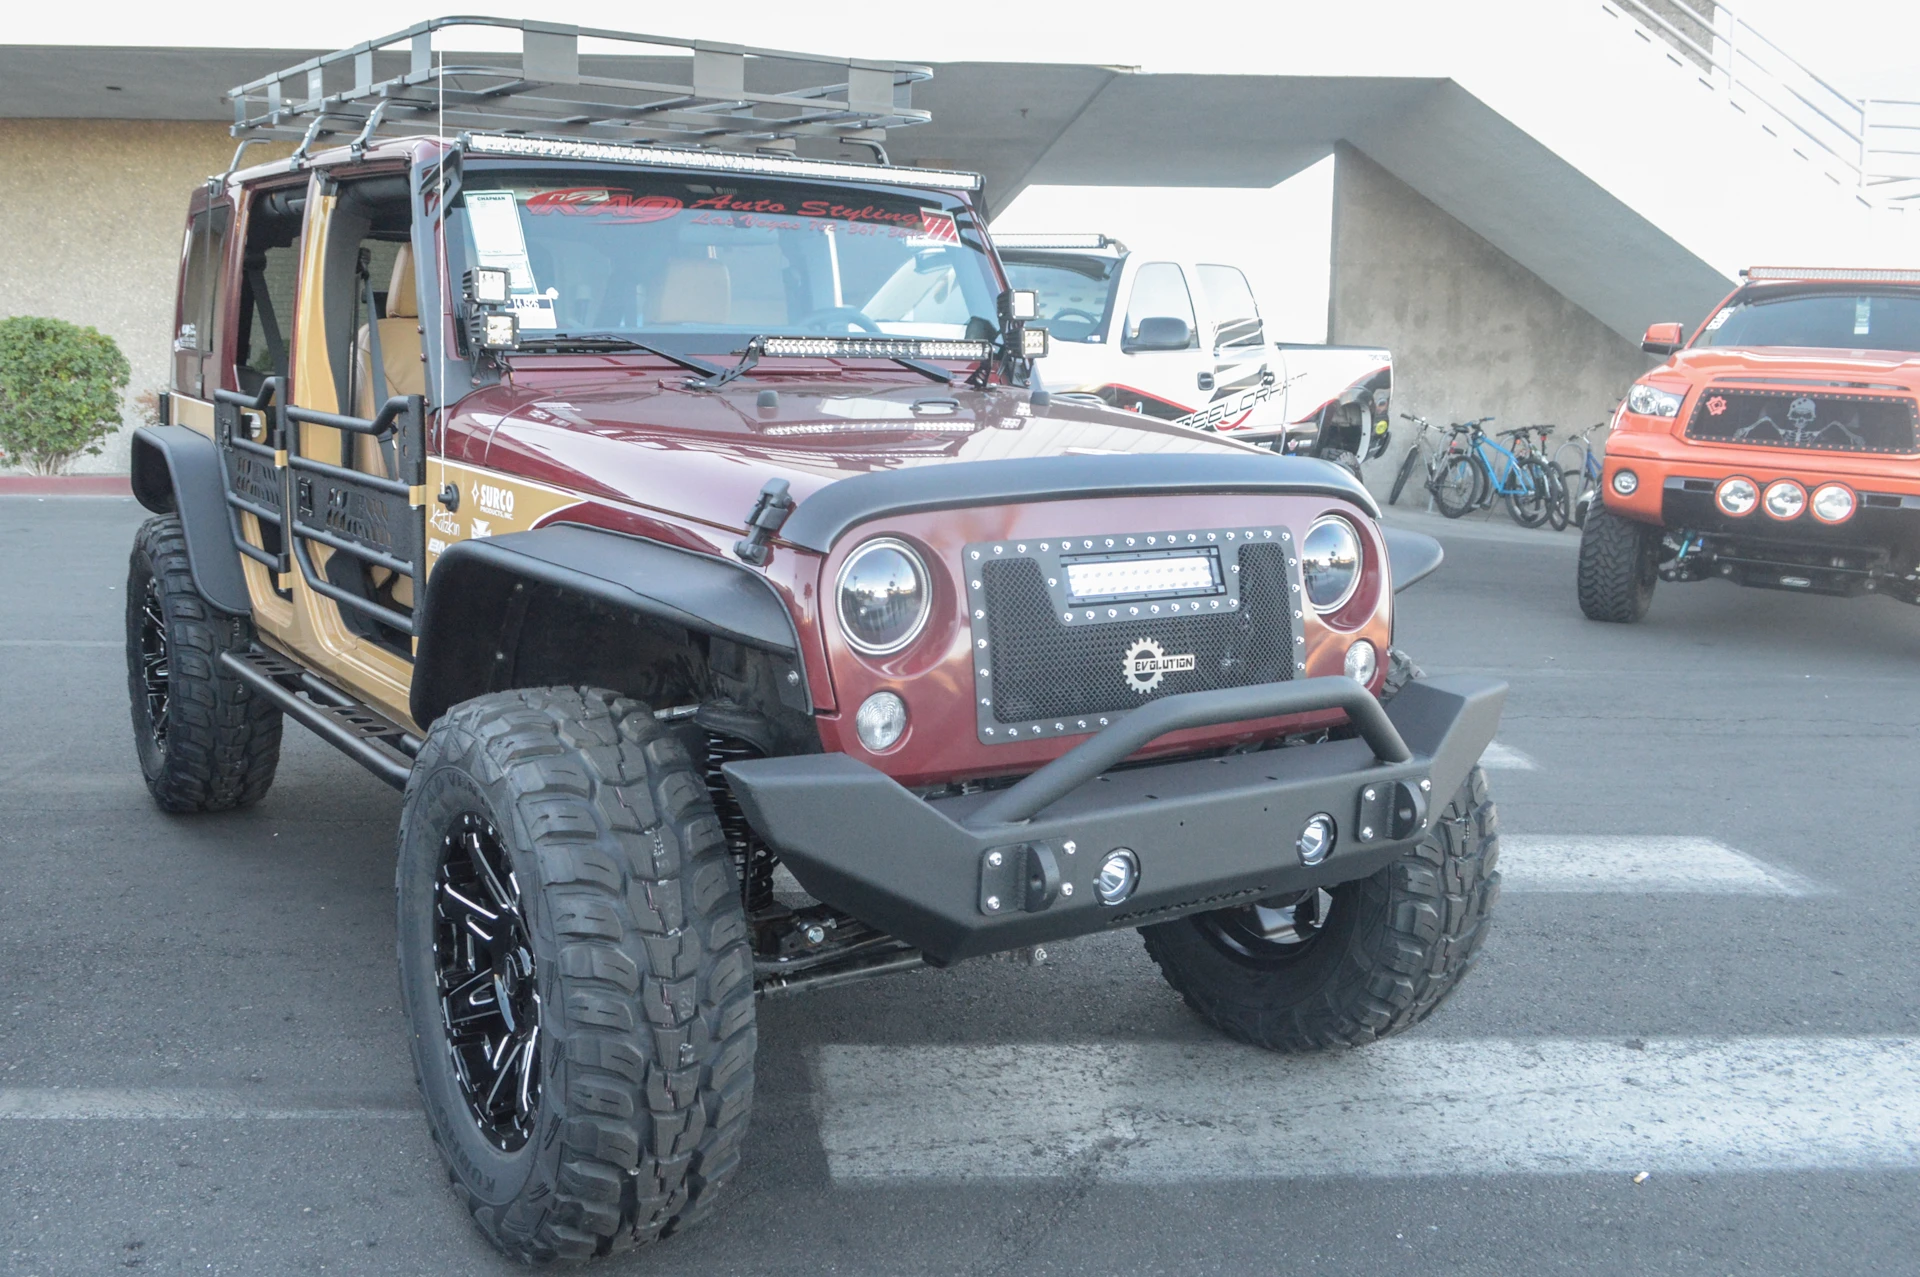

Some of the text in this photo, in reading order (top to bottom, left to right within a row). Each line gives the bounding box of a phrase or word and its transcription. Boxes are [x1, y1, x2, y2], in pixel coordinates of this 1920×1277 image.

[689, 194, 787, 212] Auto
[797, 200, 919, 227] Styling
[690, 212, 734, 225] Las
[739, 214, 801, 231] Vegas
[480, 484, 515, 513] SURCO
[1135, 657, 1193, 671] EVOLUTION
[438, 1105, 497, 1194] KUMHO
